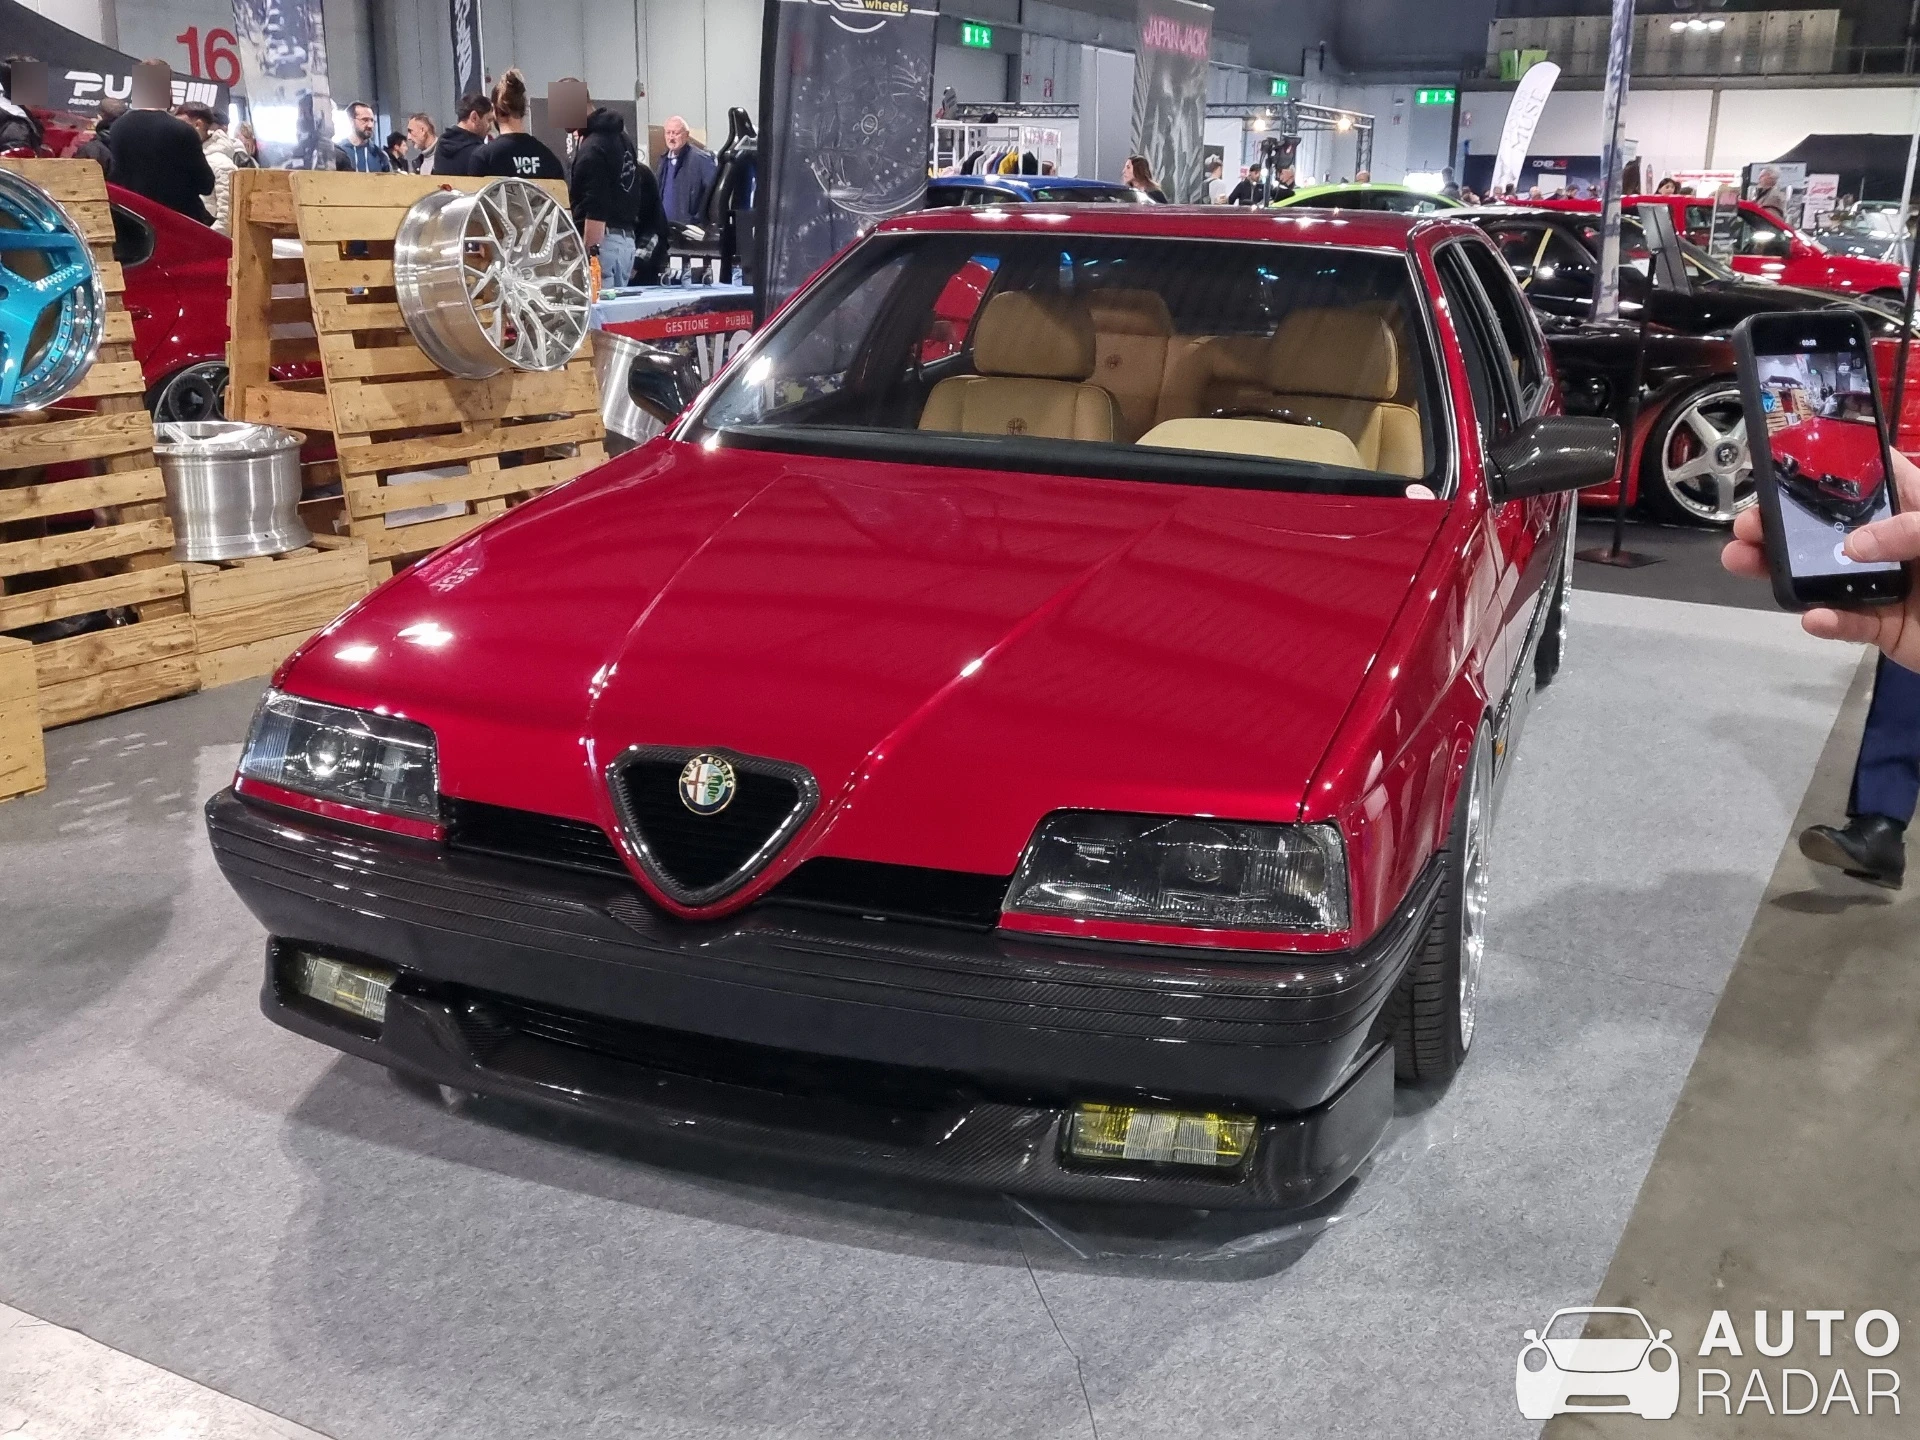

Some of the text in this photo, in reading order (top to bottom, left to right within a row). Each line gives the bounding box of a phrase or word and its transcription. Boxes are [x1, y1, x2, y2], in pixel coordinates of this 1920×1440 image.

[865, 0, 909, 13] wheels
[1144, 16, 1180, 50] JAPAN
[176, 26, 242, 88] 16
[1511, 88, 1547, 154] MUSE
[665, 318, 709, 333] GESTIONE
[681, 756, 734, 788] ALFA ROMEO
